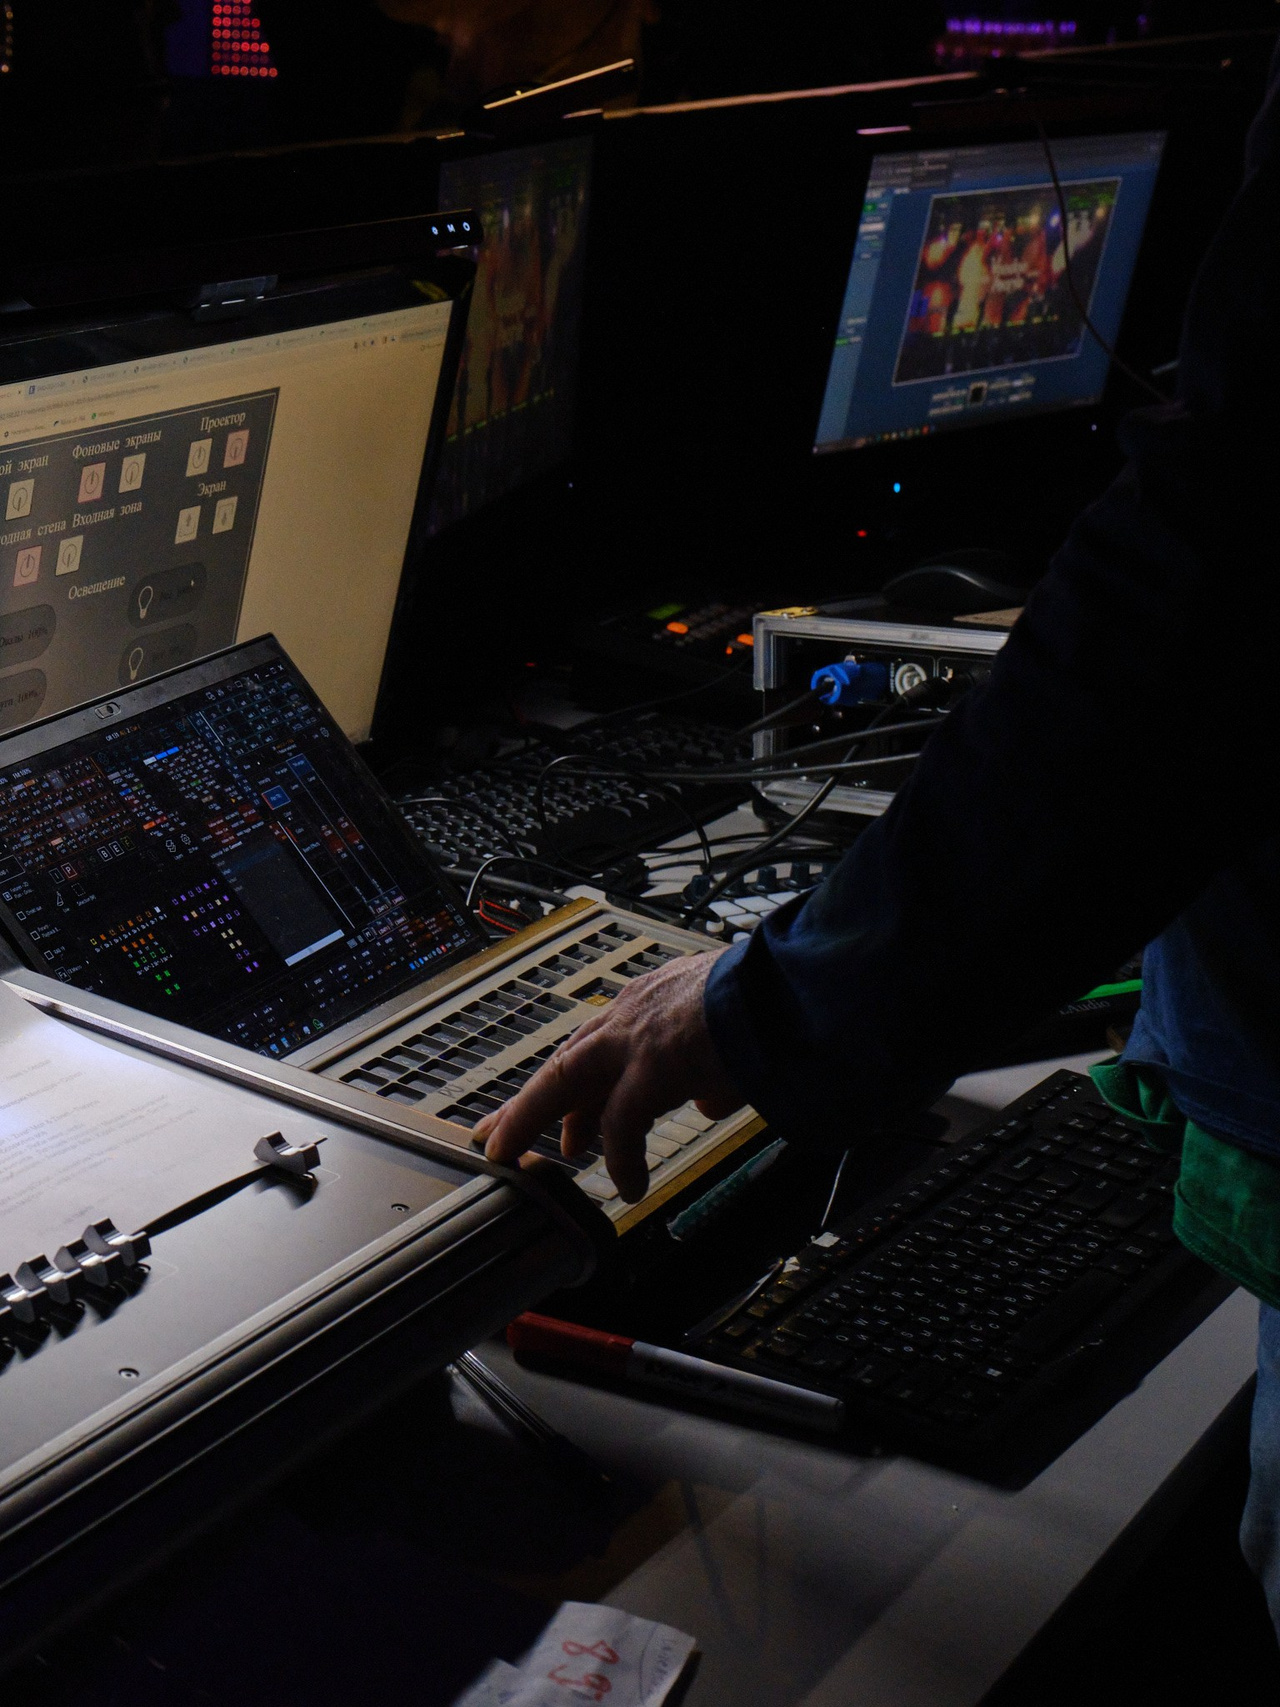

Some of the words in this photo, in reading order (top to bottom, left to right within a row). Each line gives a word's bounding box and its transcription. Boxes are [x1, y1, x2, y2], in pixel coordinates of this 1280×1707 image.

[200, 412, 246, 432] Проектор
[72, 439, 120, 459] Фоновые
[125, 430, 162, 449] экраны
[17, 454, 49, 472] экран
[197, 480, 227, 496] Экран
[72, 508, 115, 528] Входная
[120, 501, 142, 515] зона
[37, 520, 66, 536] стена
[68, 576, 125, 600] Освещение
